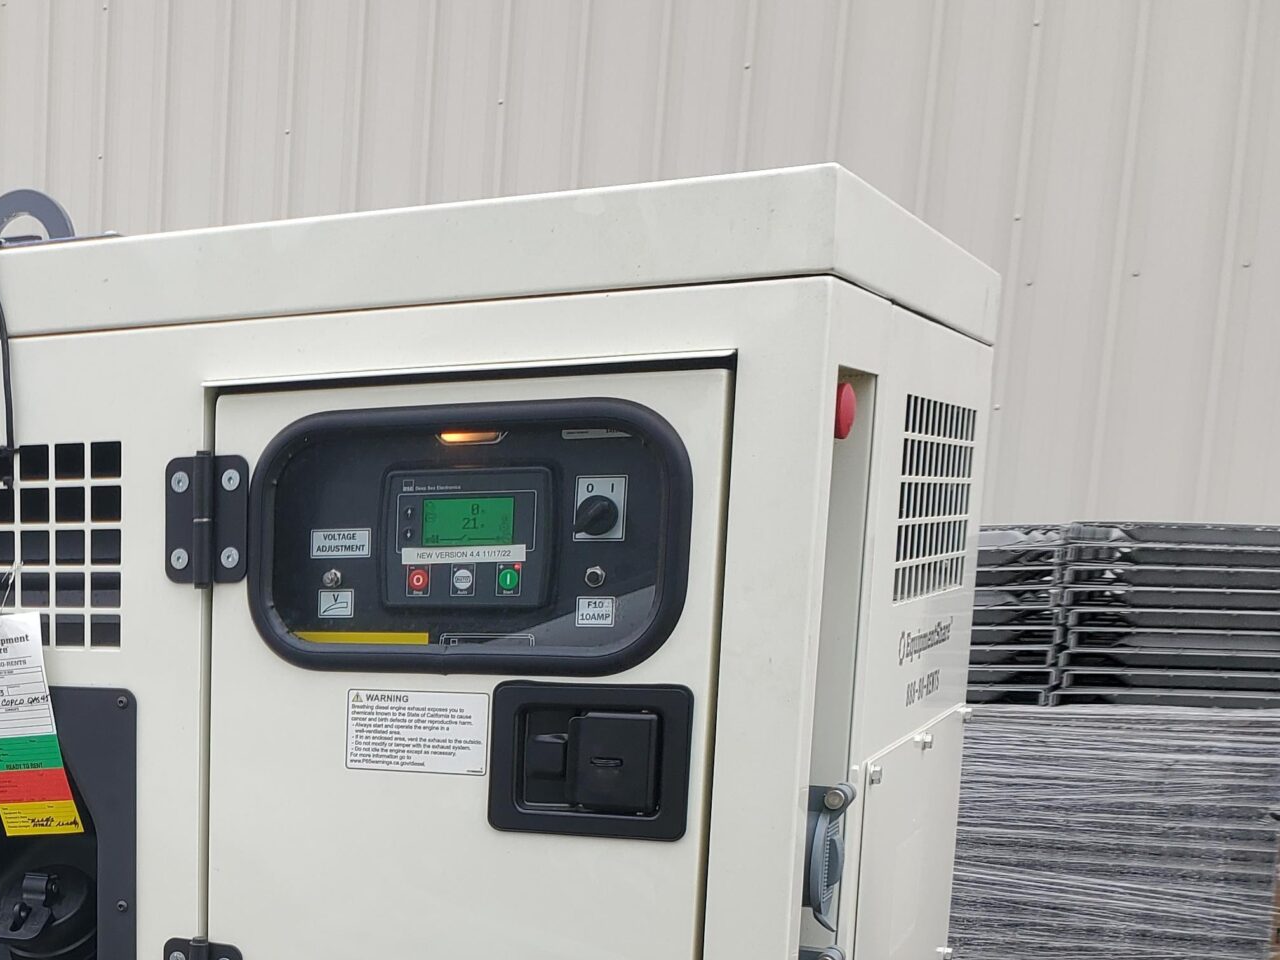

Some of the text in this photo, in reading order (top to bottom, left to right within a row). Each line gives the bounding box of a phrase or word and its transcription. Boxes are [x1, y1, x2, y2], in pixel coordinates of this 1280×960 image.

[323, 533, 357, 541] VOLTAGE
[316, 544, 365, 553] ADJUSTMENT
[416, 551, 432, 559] NEW
[580, 613, 610, 621] 10AMP
[366, 694, 409, 702] WARNING
